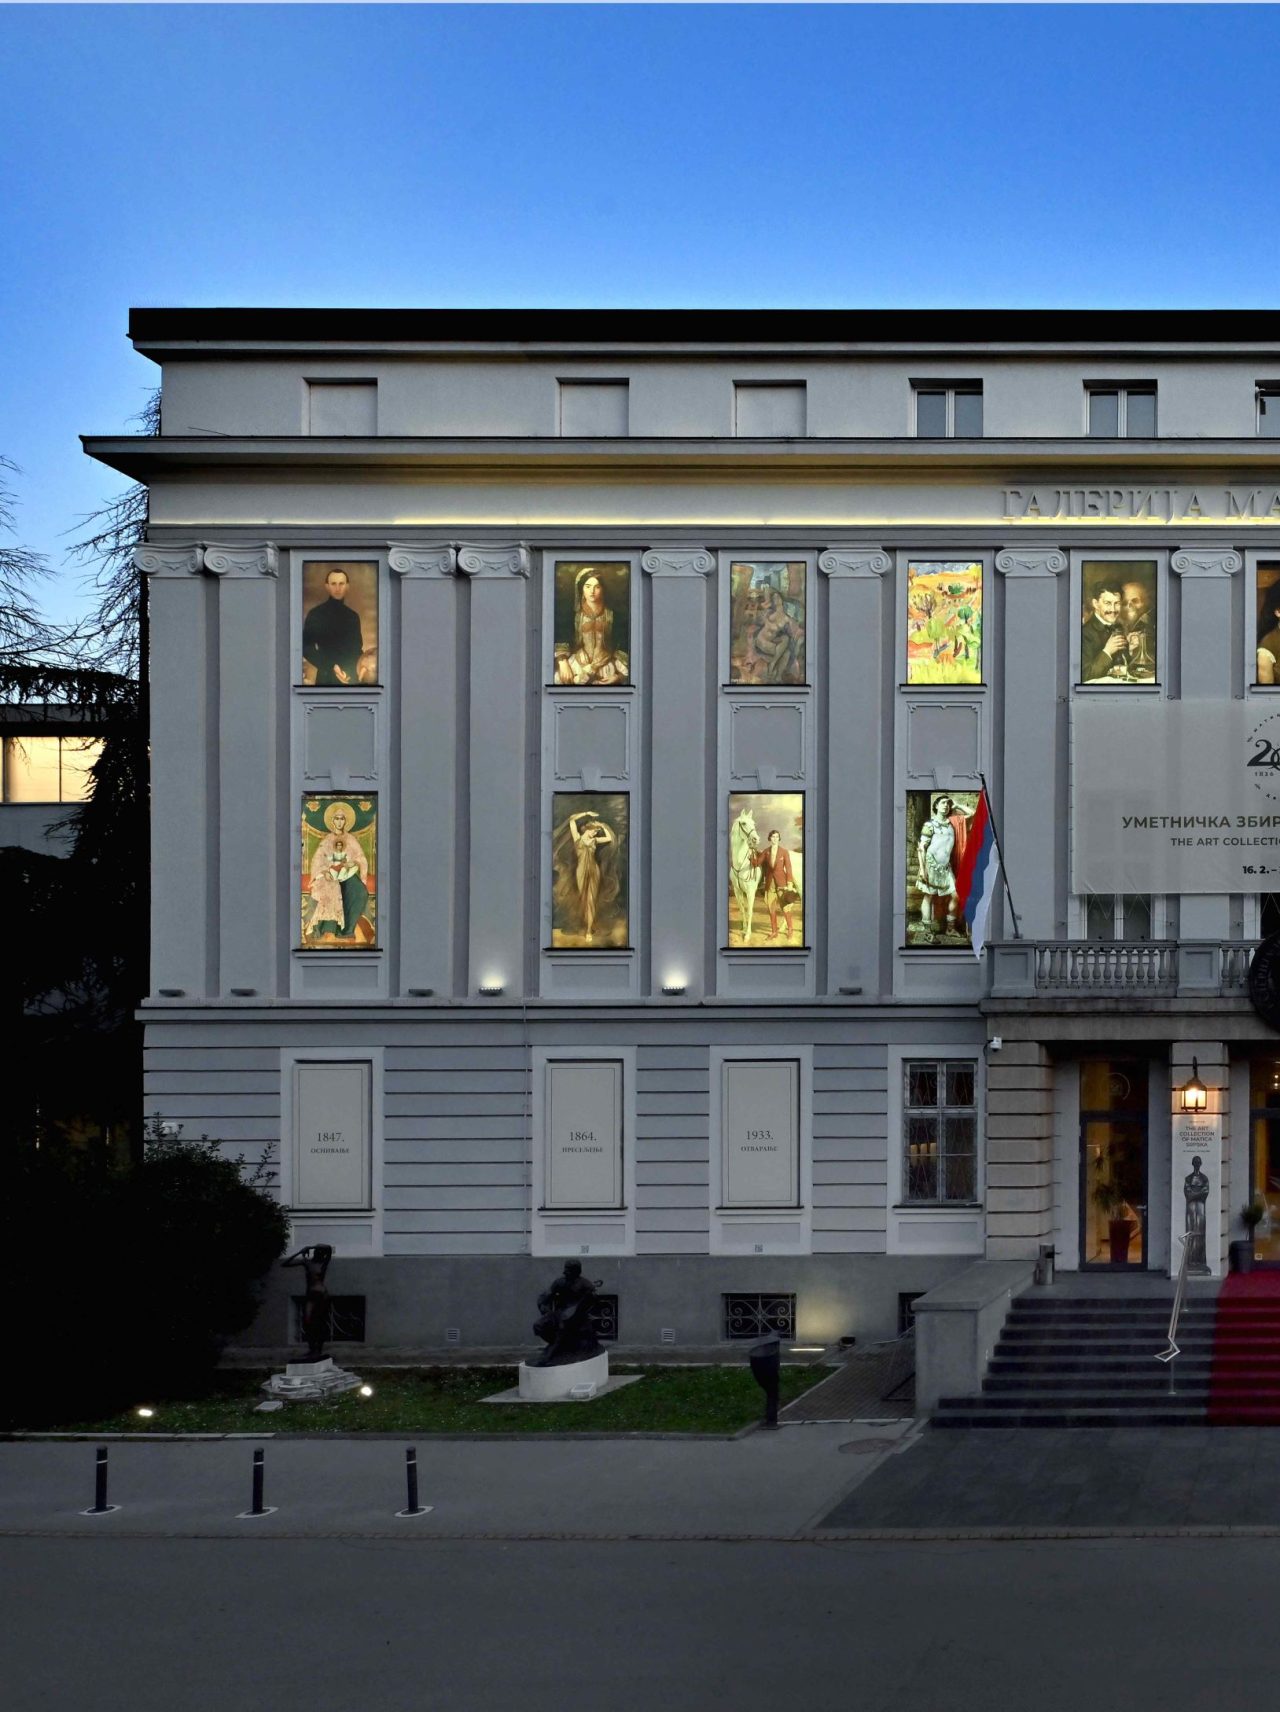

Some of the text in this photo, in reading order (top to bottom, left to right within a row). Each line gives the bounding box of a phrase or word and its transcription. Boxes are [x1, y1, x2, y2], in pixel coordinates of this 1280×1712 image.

[1001, 490, 1212, 523] ГАЛЕРИЈА
[1122, 816, 1231, 828] УМЕТНИЧКА
[1170, 837, 1193, 846] THE
[1196, 837, 1219, 846] ART
[1242, 865, 1257, 874] 16.
[1259, 865, 1270, 874] 2.
[317, 1132, 345, 1142] 1847.
[569, 1131, 597, 1141] 1864.
[746, 1130, 774, 1140] 1933.
